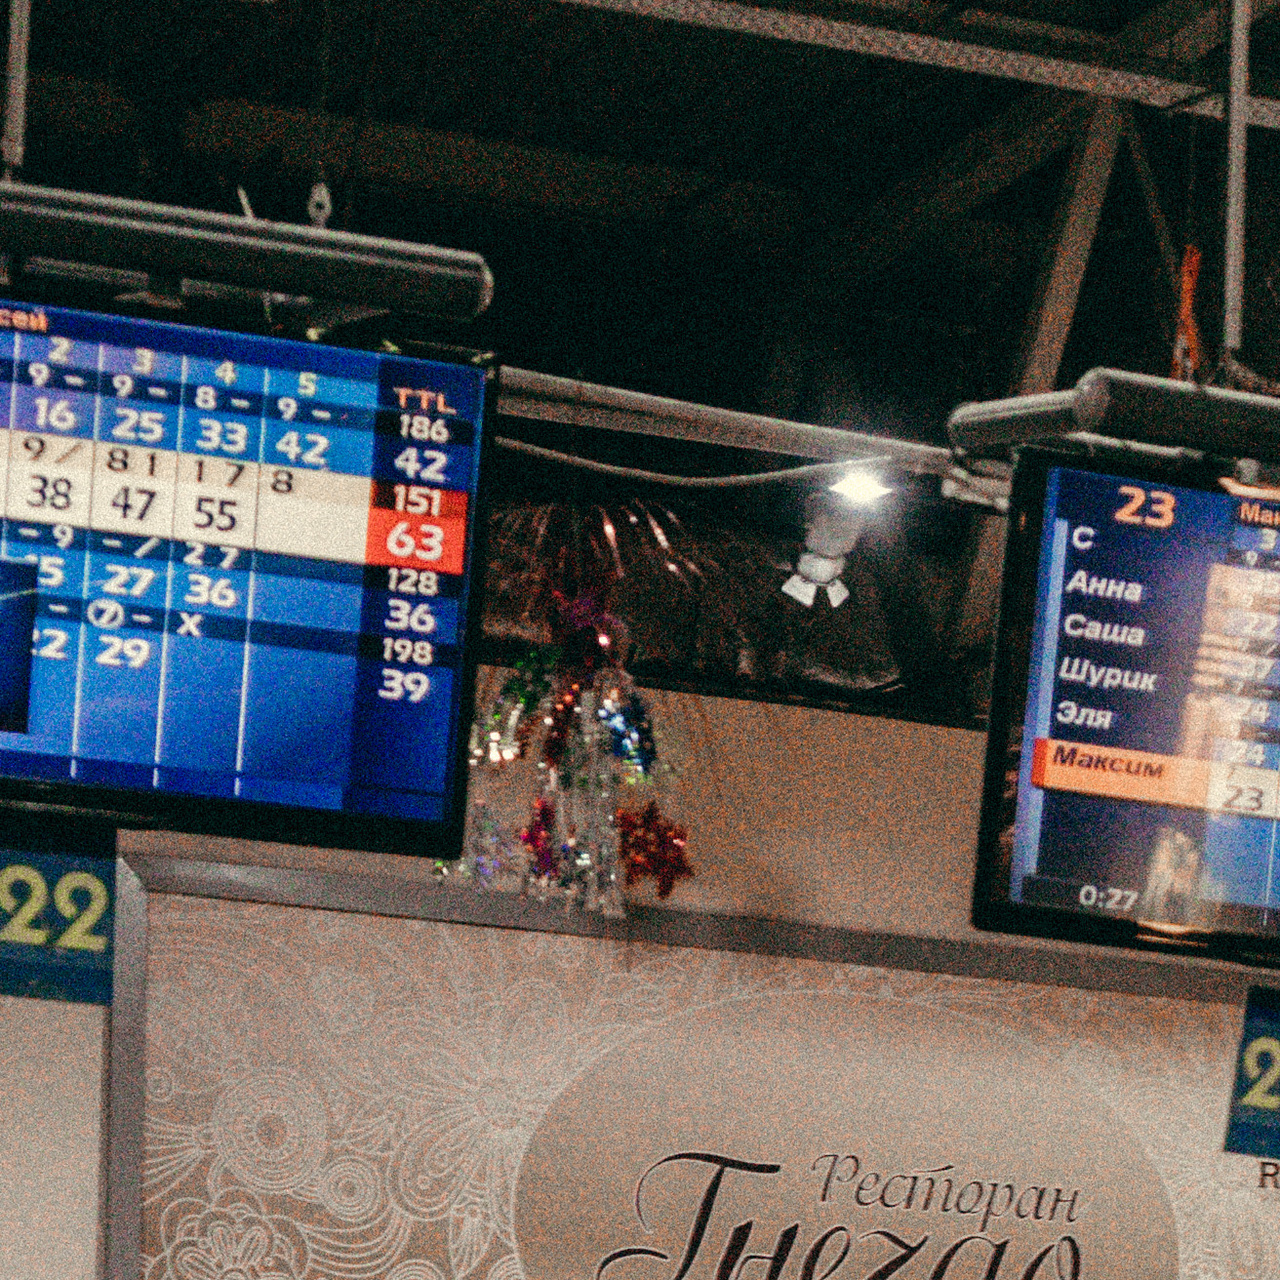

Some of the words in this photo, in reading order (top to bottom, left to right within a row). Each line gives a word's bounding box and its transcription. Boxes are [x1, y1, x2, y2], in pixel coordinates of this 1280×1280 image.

[50, 336, 70, 364] 2
[133, 348, 154, 373] 3
[215, 360, 236, 386] 4
[298, 371, 318, 397] 5
[28, 363, 49, 387] 9
[113, 374, 133, 398] 9
[195, 386, 217, 411] 8
[277, 397, 298, 421] 9
[399, 413, 449, 444] 186
[394, 387, 457, 414] TTL
[35, 397, 76, 431] 16
[112, 408, 164, 442] 25
[196, 418, 248, 453] 33
[275, 431, 330, 466] 42
[394, 447, 450, 483] 42
[23, 436, 45, 461] 9
[107, 448, 129, 473] 8
[226, 462, 245, 487] 7
[271, 470, 294, 494] 8
[392, 485, 443, 517] 151
[27, 474, 71, 510] 38
[112, 486, 156, 521] 47
[194, 497, 237, 532] 55
[385, 522, 445, 562] 63
[1114, 486, 1176, 528] 23
[1259, 527, 1277, 551] 3
[53, 525, 74, 549] 9
[183, 541, 206, 567] 2
[219, 547, 240, 570] 7
[387, 567, 438, 597] 128
[102, 564, 155, 597] 27
[184, 573, 237, 609] 36
[384, 598, 436, 634] 36
[1065, 570, 1143, 603] Анна
[1063, 613, 1145, 647] Саша
[96, 635, 151, 668] 29
[378, 668, 431, 703] 39
[382, 637, 434, 667] 198
[1059, 656, 1159, 692] Шурик
[1056, 700, 1113, 730] Эля
[1053, 744, 1164, 779] Максим
[1223, 785, 1264, 812] 23
[0, 863, 109, 952] 22
[1078, 885, 1139, 911] 0:27
[811, 1153, 1083, 1233] Ресторан
